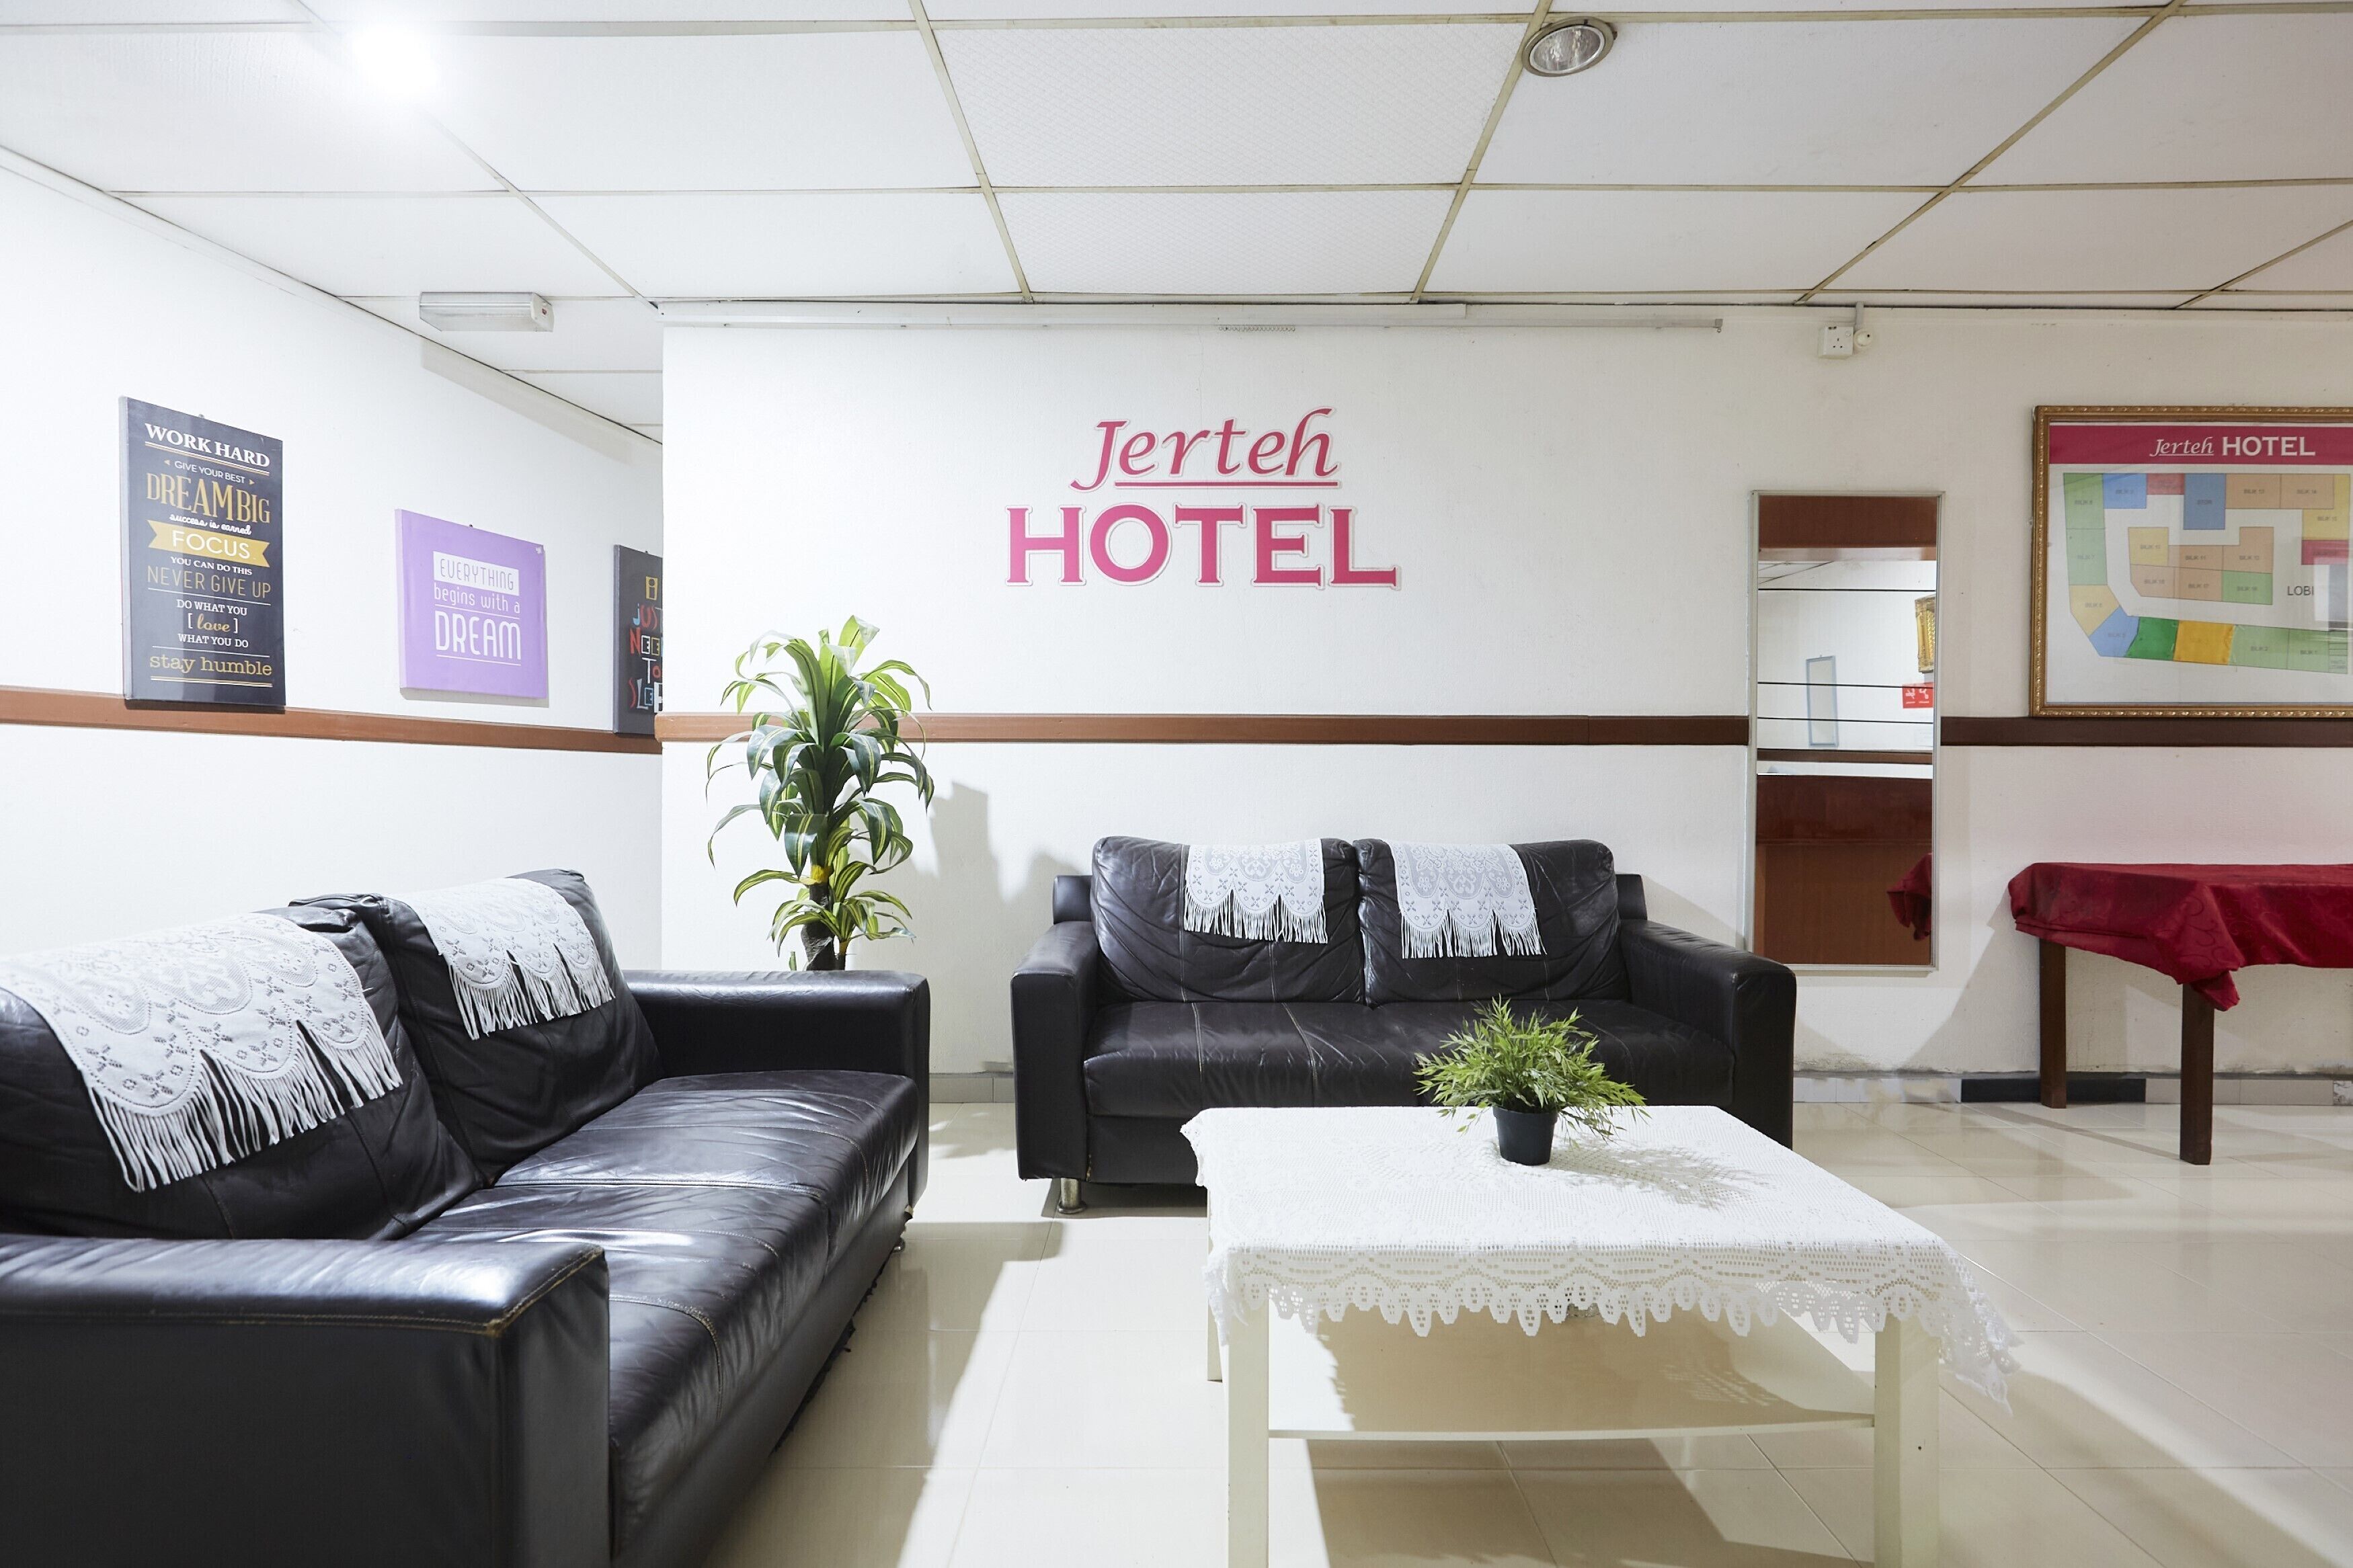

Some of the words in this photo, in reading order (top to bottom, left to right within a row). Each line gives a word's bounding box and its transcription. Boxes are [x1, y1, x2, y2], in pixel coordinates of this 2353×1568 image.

[145, 423, 212, 454] WORK
[214, 441, 270, 467] HARD
[1069, 406, 1339, 492] Jerteh
[2149, 437, 2215, 456] Jerteh
[2222, 436, 2316, 456] HOTEL
[174, 460, 197, 472] GIVE
[198, 466, 224, 479] YOUR
[225, 472, 246, 484] BEST
[147, 472, 234, 521] DREAM
[236, 489, 270, 523] BIG
[169, 513, 208, 527] success
[209, 520, 220, 529] is
[221, 524, 251, 536] earned
[171, 530, 251, 559] FOCUS
[1006, 503, 1401, 589] HOTEL
[171, 556, 192, 566] YOU
[194, 560, 214, 570] CAN
[216, 563, 231, 572] DO
[233, 566, 253, 575] THIS
[440, 559, 514, 590] EVERYTHING
[147, 565, 205, 590] NEVER
[210, 574, 246, 596] GIVE
[252, 580, 271, 599] UP
[2287, 585, 2314, 596] LOBI
[177, 599, 192, 609] DO
[194, 601, 225, 613] WHAT
[227, 606, 247, 616] YOU
[434, 582, 475, 606] begins
[481, 593, 508, 612] with
[514, 601, 520, 614] a
[197, 613, 231, 632] love
[435, 610, 521, 660] DREAM
[177, 633, 210, 644] WHAT
[210, 636, 232, 647] YOU
[235, 639, 249, 648] DO
[630, 627, 663, 657] NEE
[149, 654, 196, 673] stay
[200, 657, 272, 676] humble
